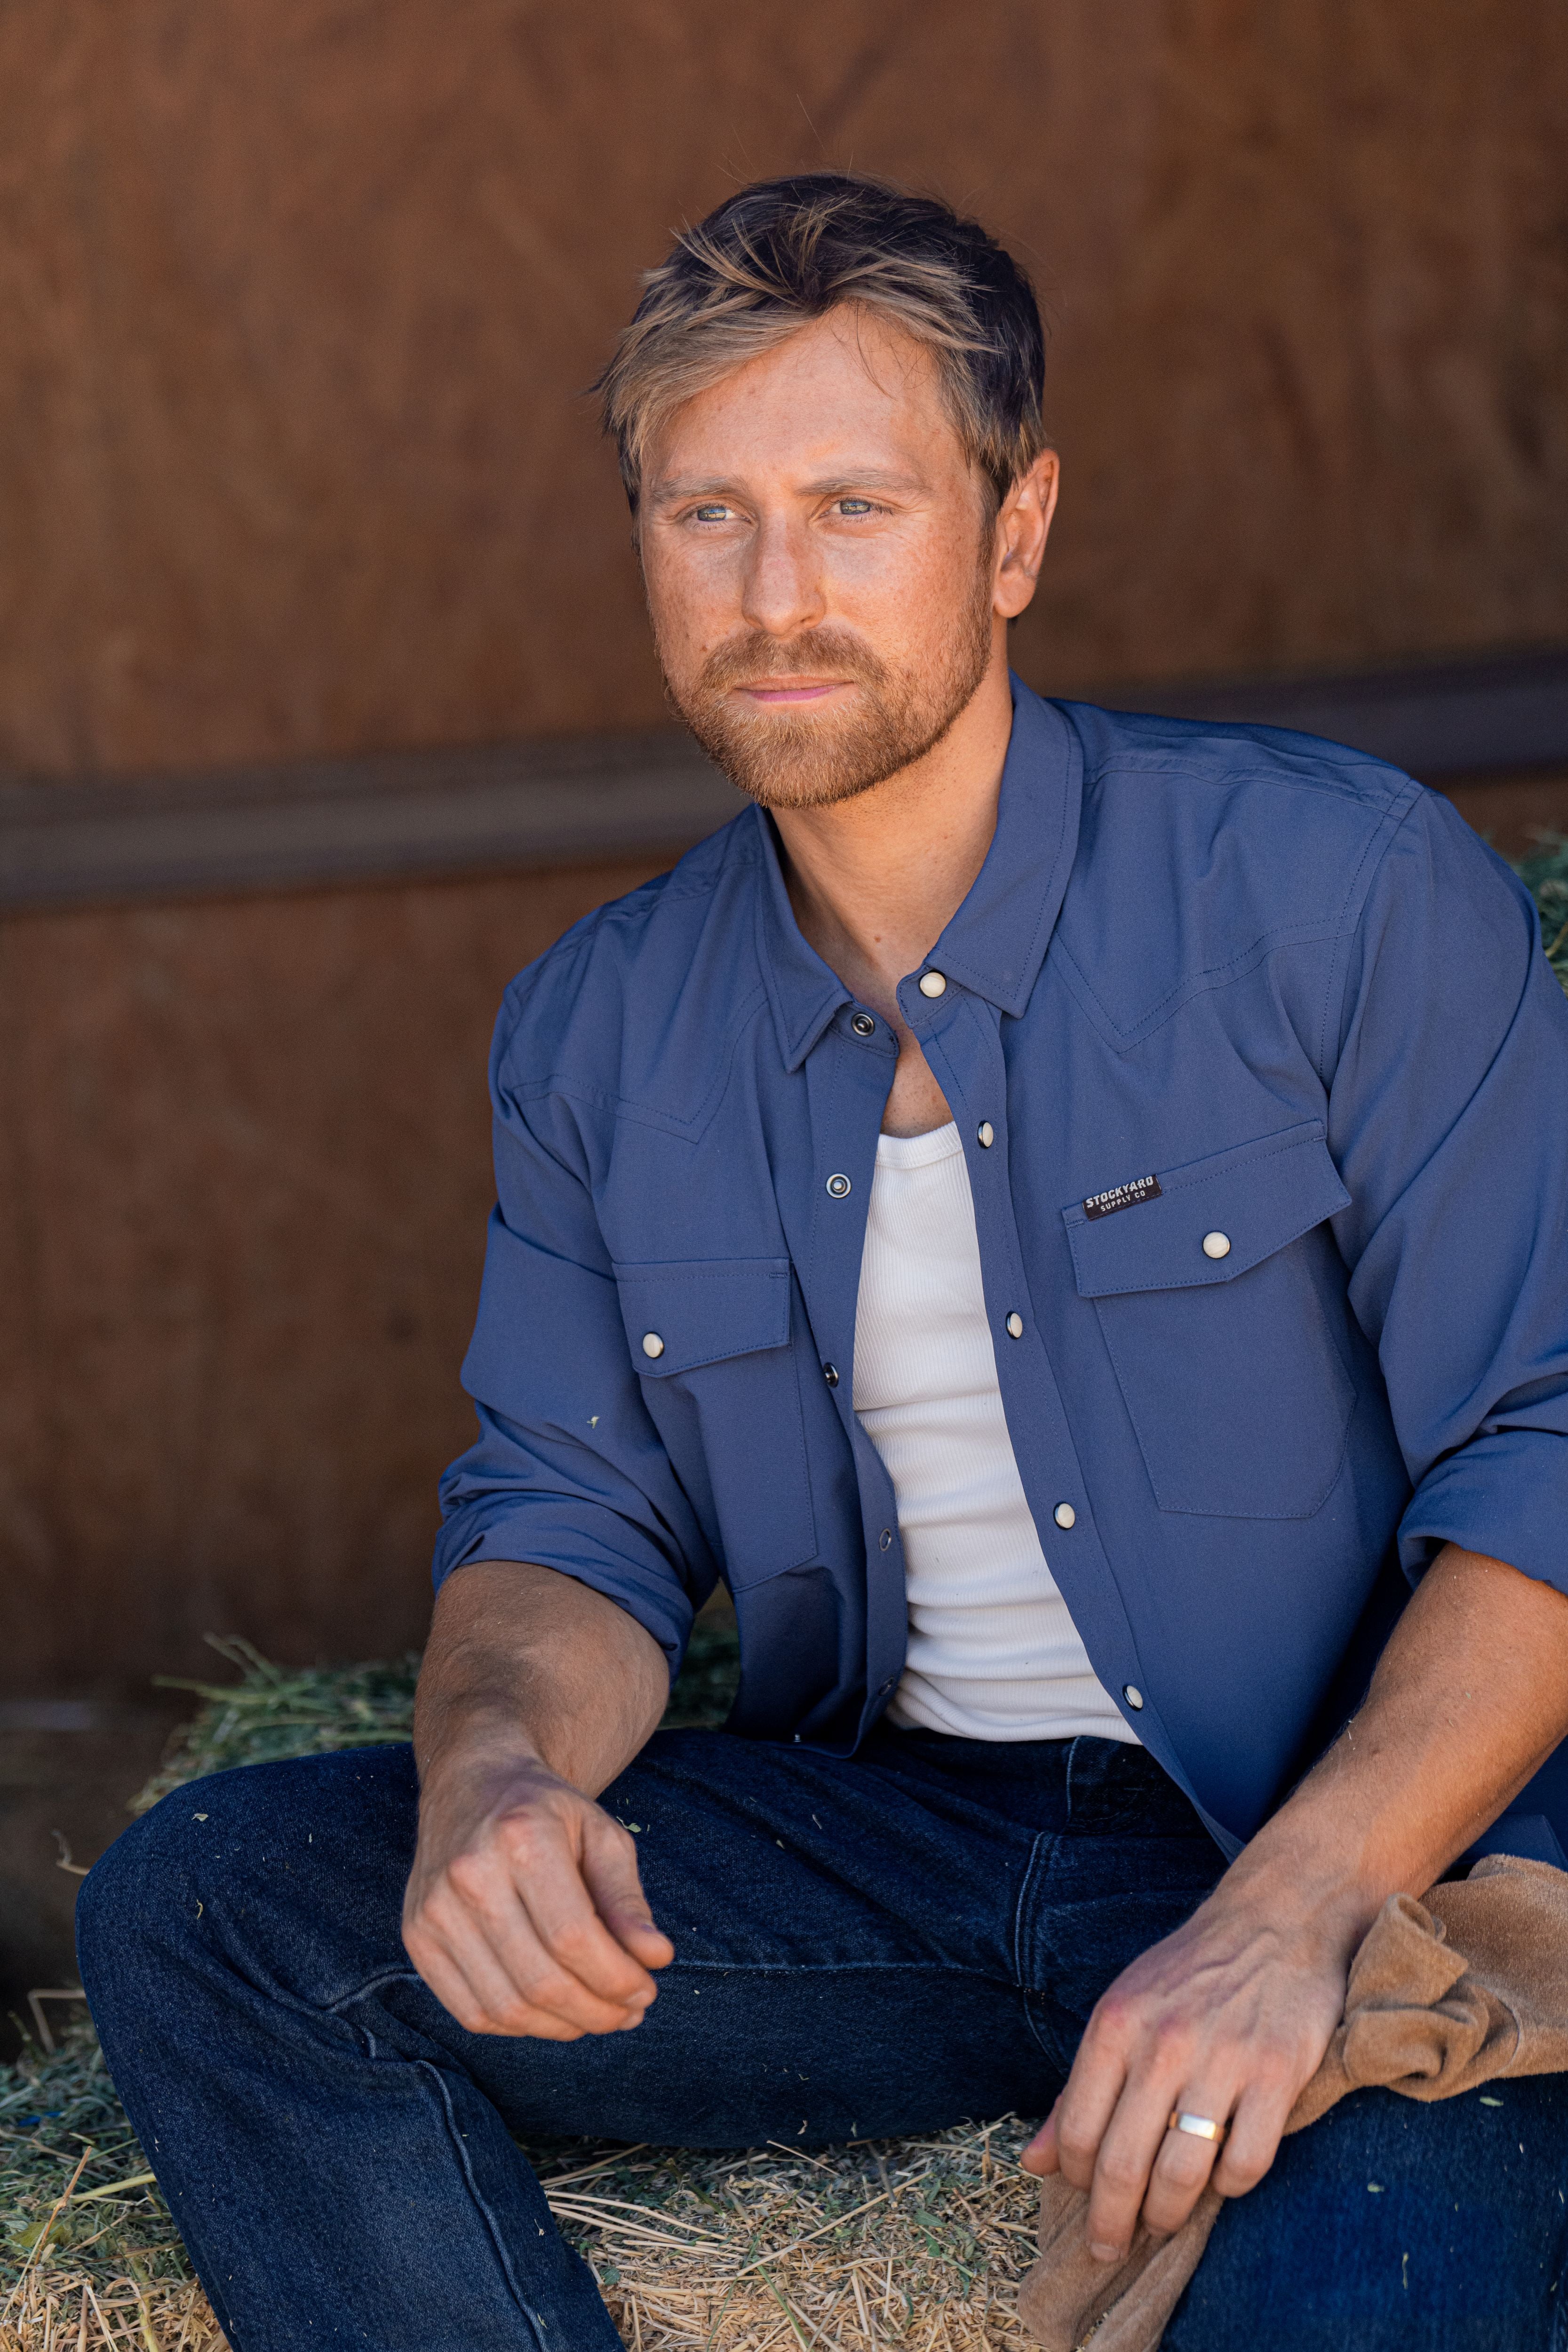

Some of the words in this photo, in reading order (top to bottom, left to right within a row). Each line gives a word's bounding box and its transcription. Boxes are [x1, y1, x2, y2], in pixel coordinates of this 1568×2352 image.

[1086, 1176, 1154, 1208] STOCKYARD
[1100, 1195, 1131, 1212] SUPPLY
[1135, 1190, 1146, 1199] CO
